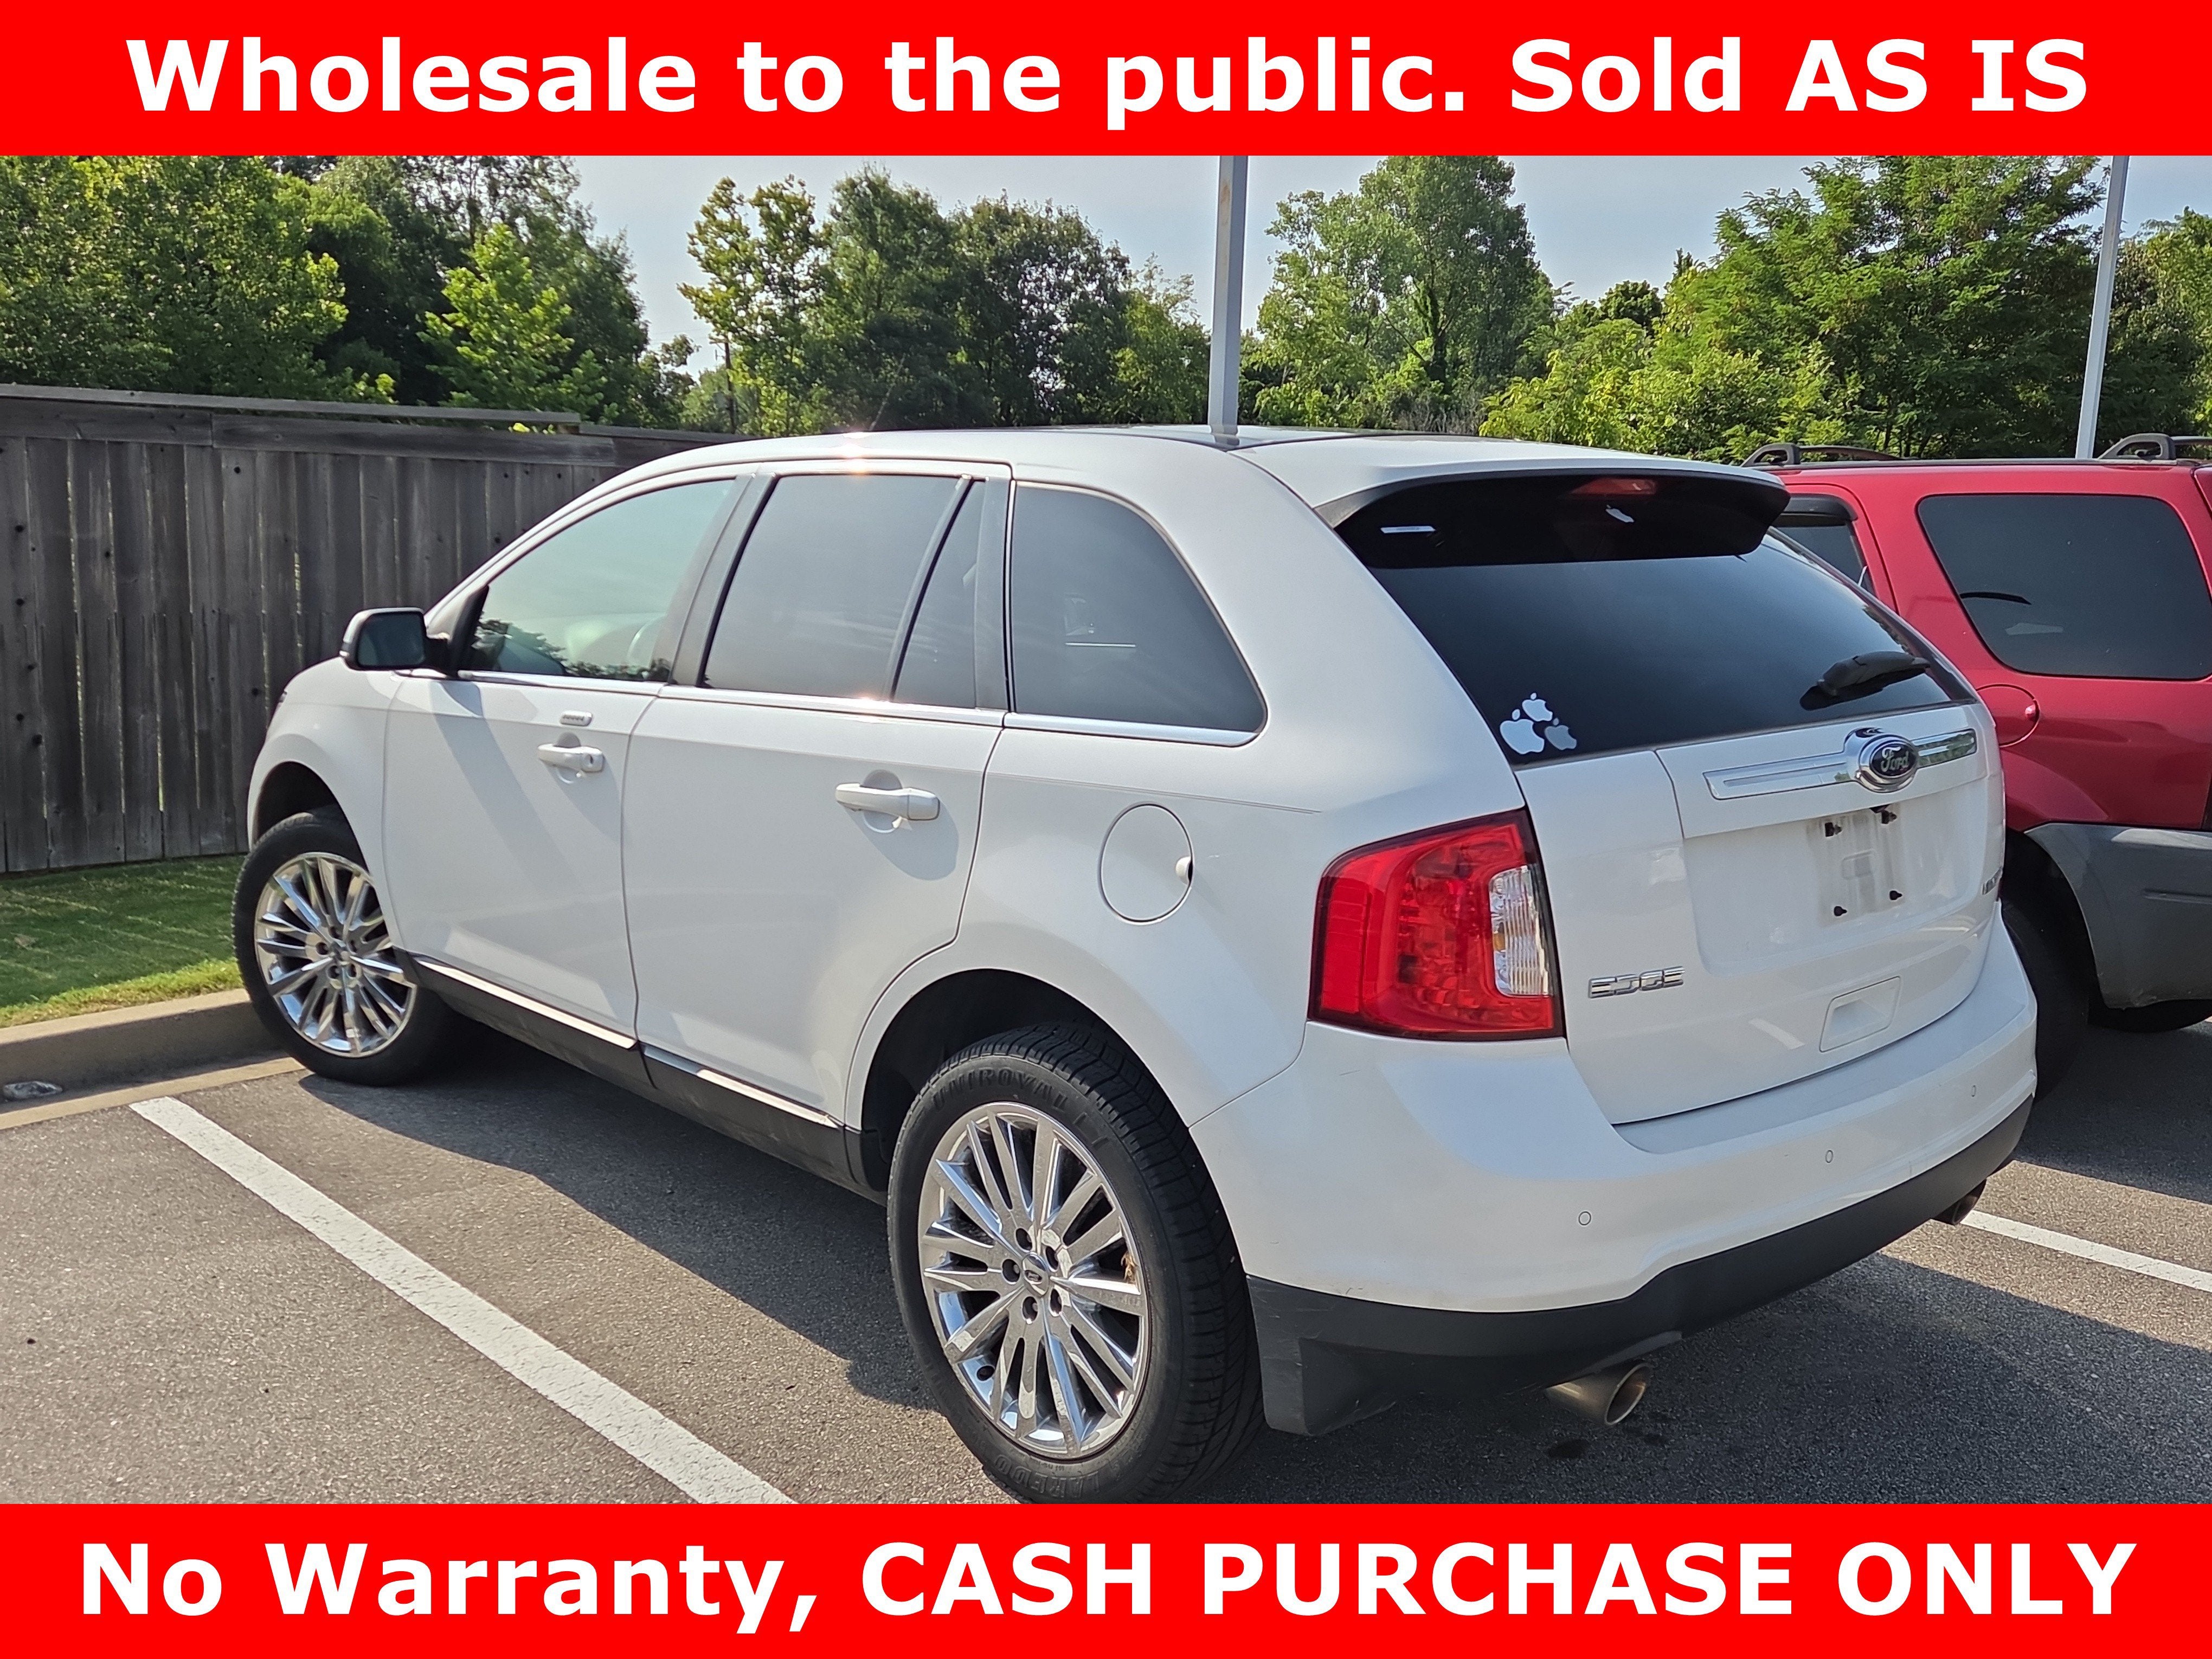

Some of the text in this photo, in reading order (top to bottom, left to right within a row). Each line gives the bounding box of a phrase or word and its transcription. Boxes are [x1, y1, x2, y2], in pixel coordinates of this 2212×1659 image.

[1880, 746, 1909, 773] Ford
[1588, 965, 1686, 999] EDGE
[932, 1066, 1069, 1114] UNIROYAL
